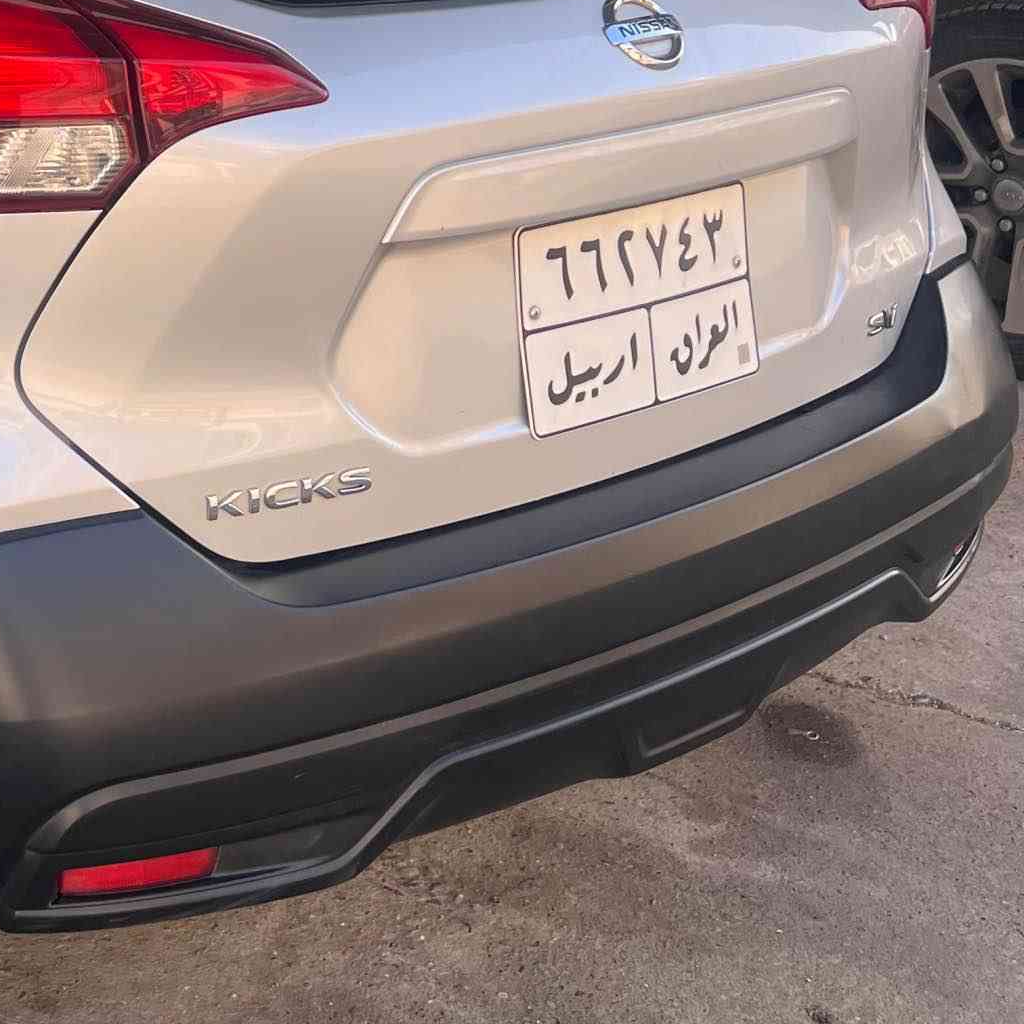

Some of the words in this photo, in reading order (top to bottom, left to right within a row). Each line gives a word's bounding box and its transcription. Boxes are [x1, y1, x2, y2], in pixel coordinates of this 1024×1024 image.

[545, 209, 724, 301] ٦٦٢٧٤٣
[547, 332, 639, 406] اربيل
[205, 465, 373, 521] KICKS
